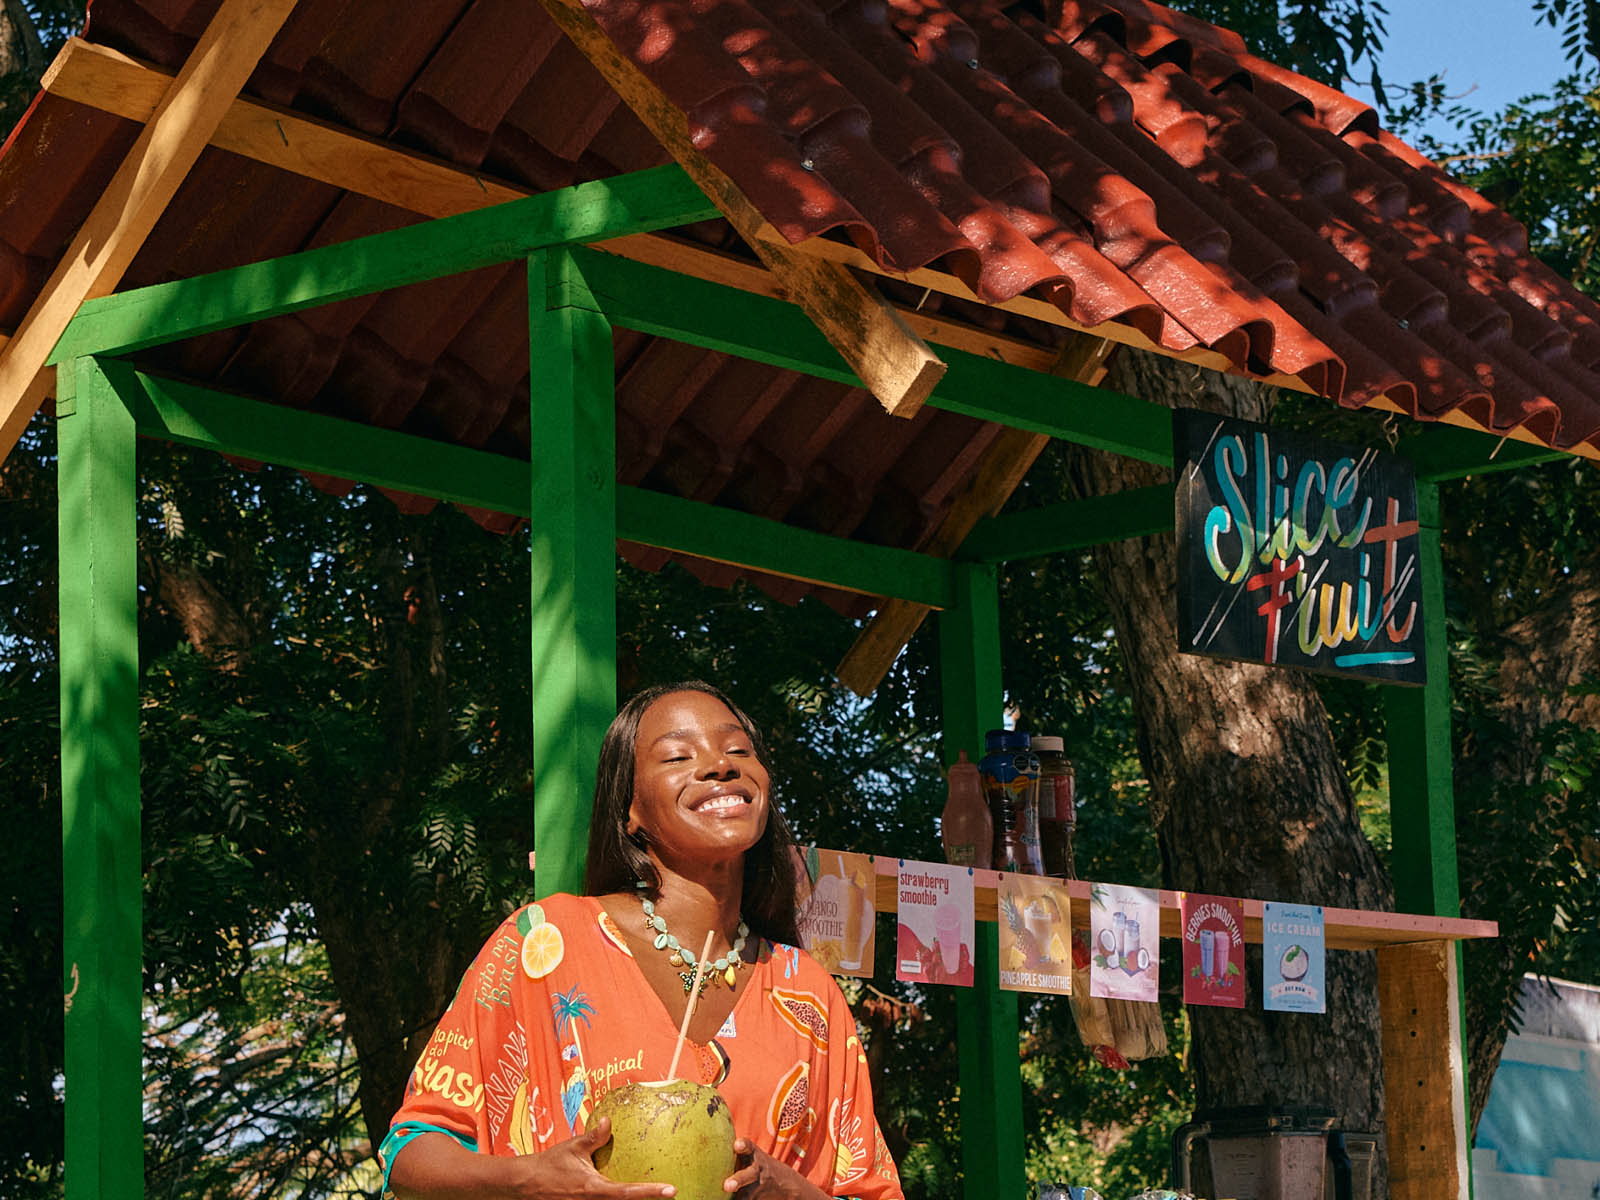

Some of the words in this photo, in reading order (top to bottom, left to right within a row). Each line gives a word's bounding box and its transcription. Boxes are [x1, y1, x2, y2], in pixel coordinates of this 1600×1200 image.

[1204, 432, 1373, 584] Slice
[1247, 496, 1419, 663] Fruit
[900, 872, 949, 895] strawberry
[900, 889, 937, 906] smoothie
[1185, 903, 1211, 943] BERRIES
[1211, 903, 1242, 948] SMOOTHIE
[491, 935, 519, 1007] Brasil
[1000, 970, 1037, 986] PINEAPPLE
[1038, 974, 1071, 990] SMOOTHIE
